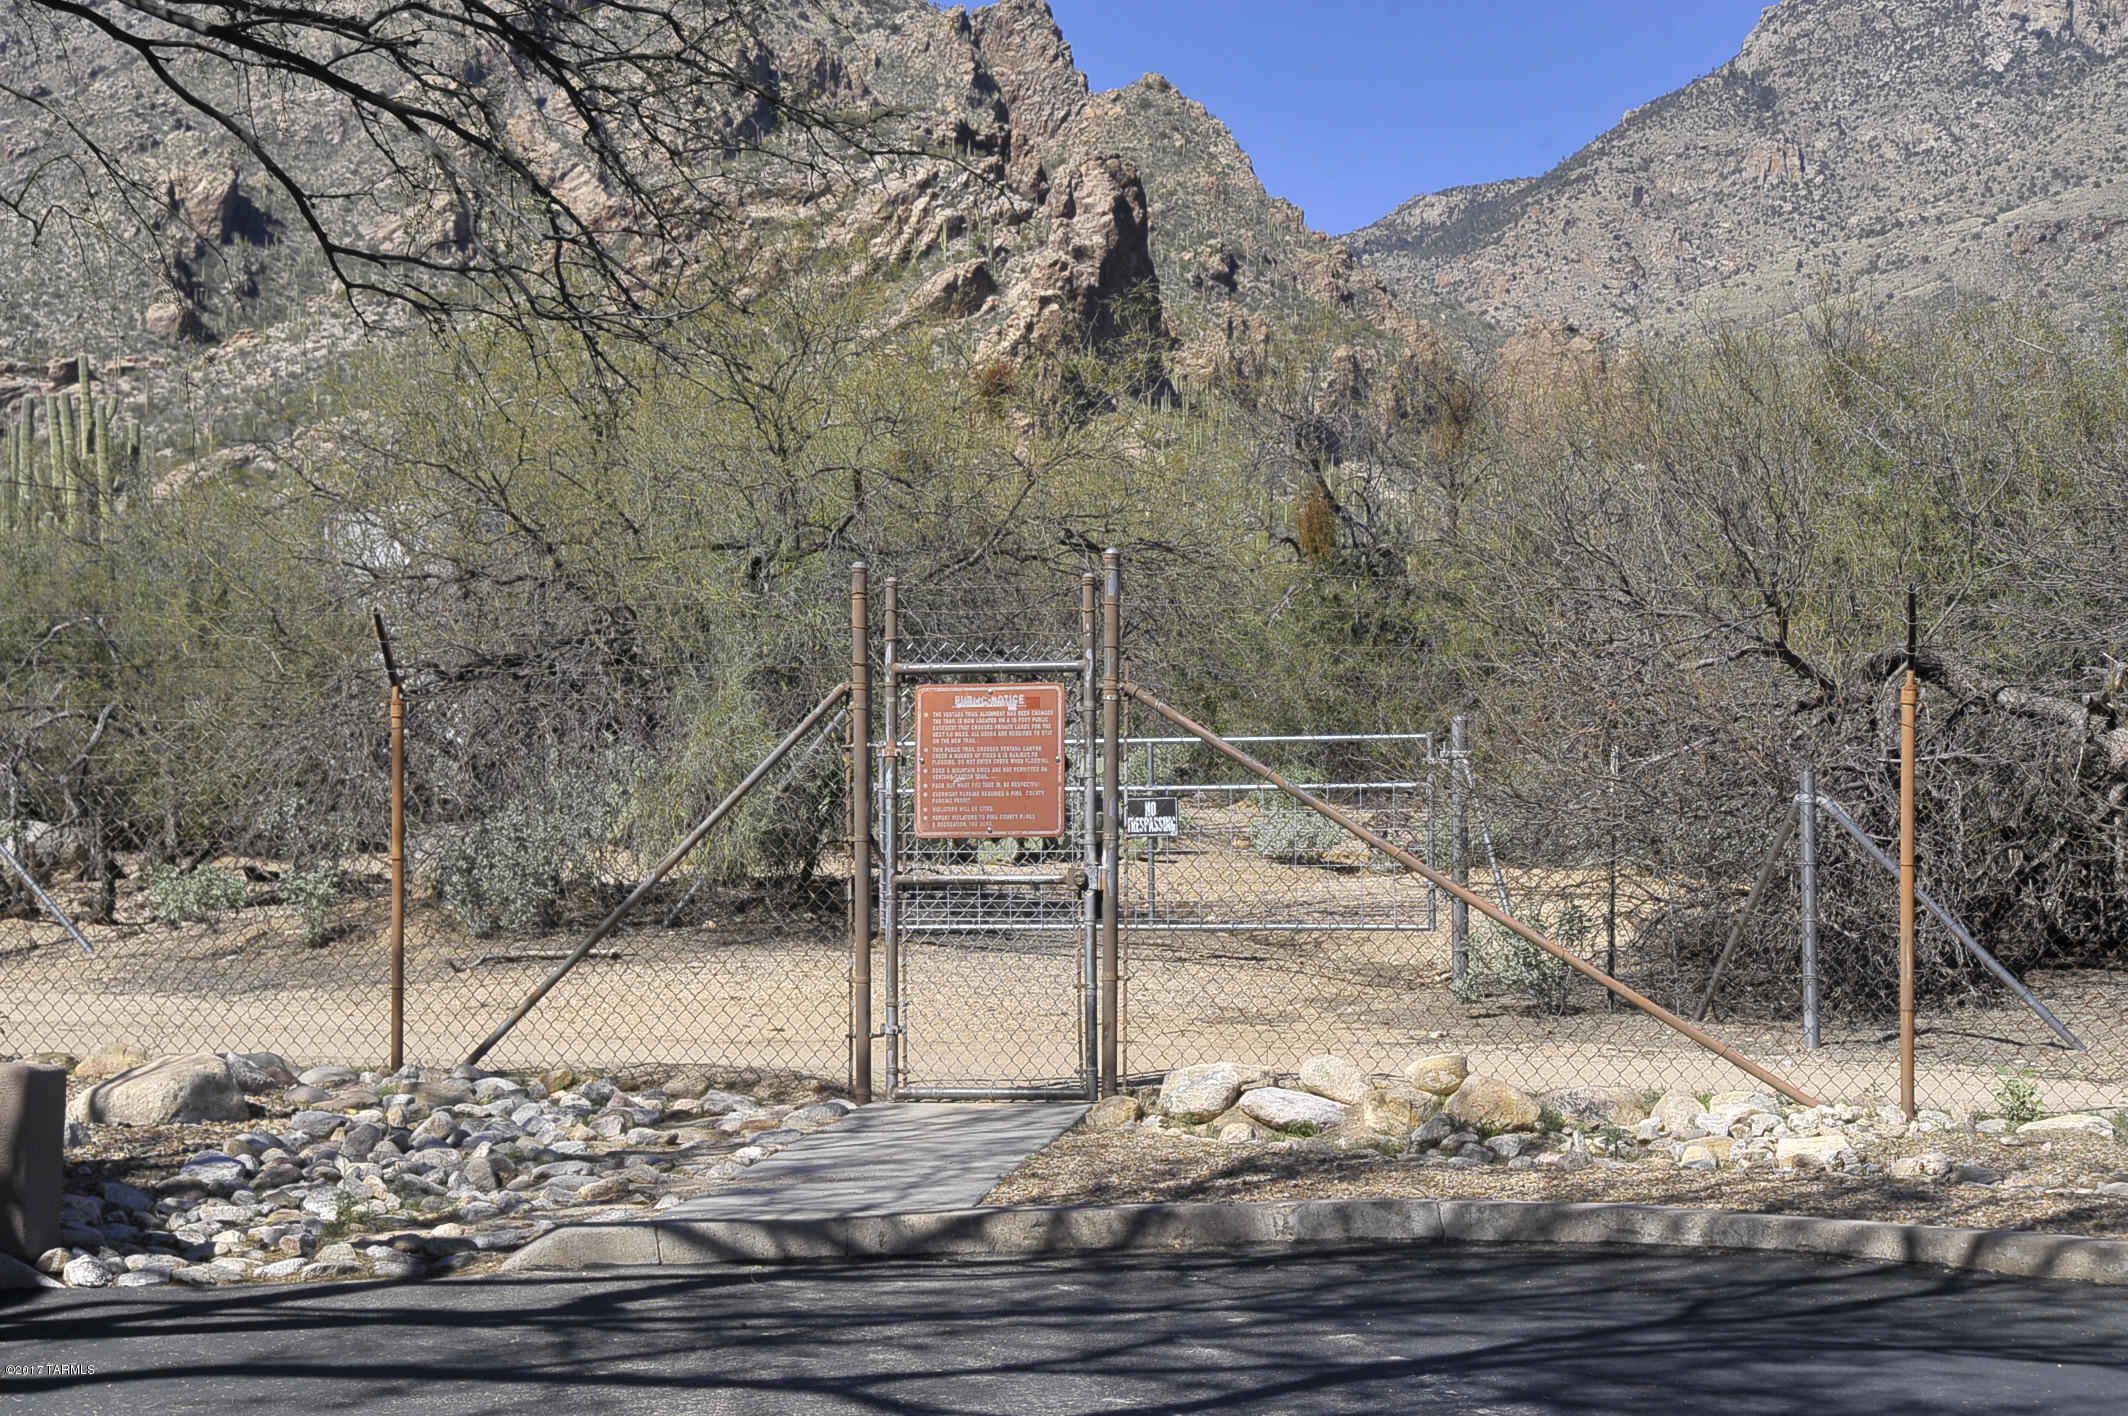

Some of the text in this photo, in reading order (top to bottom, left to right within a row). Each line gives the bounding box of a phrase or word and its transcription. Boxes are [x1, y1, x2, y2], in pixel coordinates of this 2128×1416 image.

[992, 695, 1024, 705] NOTICE
[1145, 801, 1157, 817] NO
[1127, 816, 1176, 833] TRESPASSING
